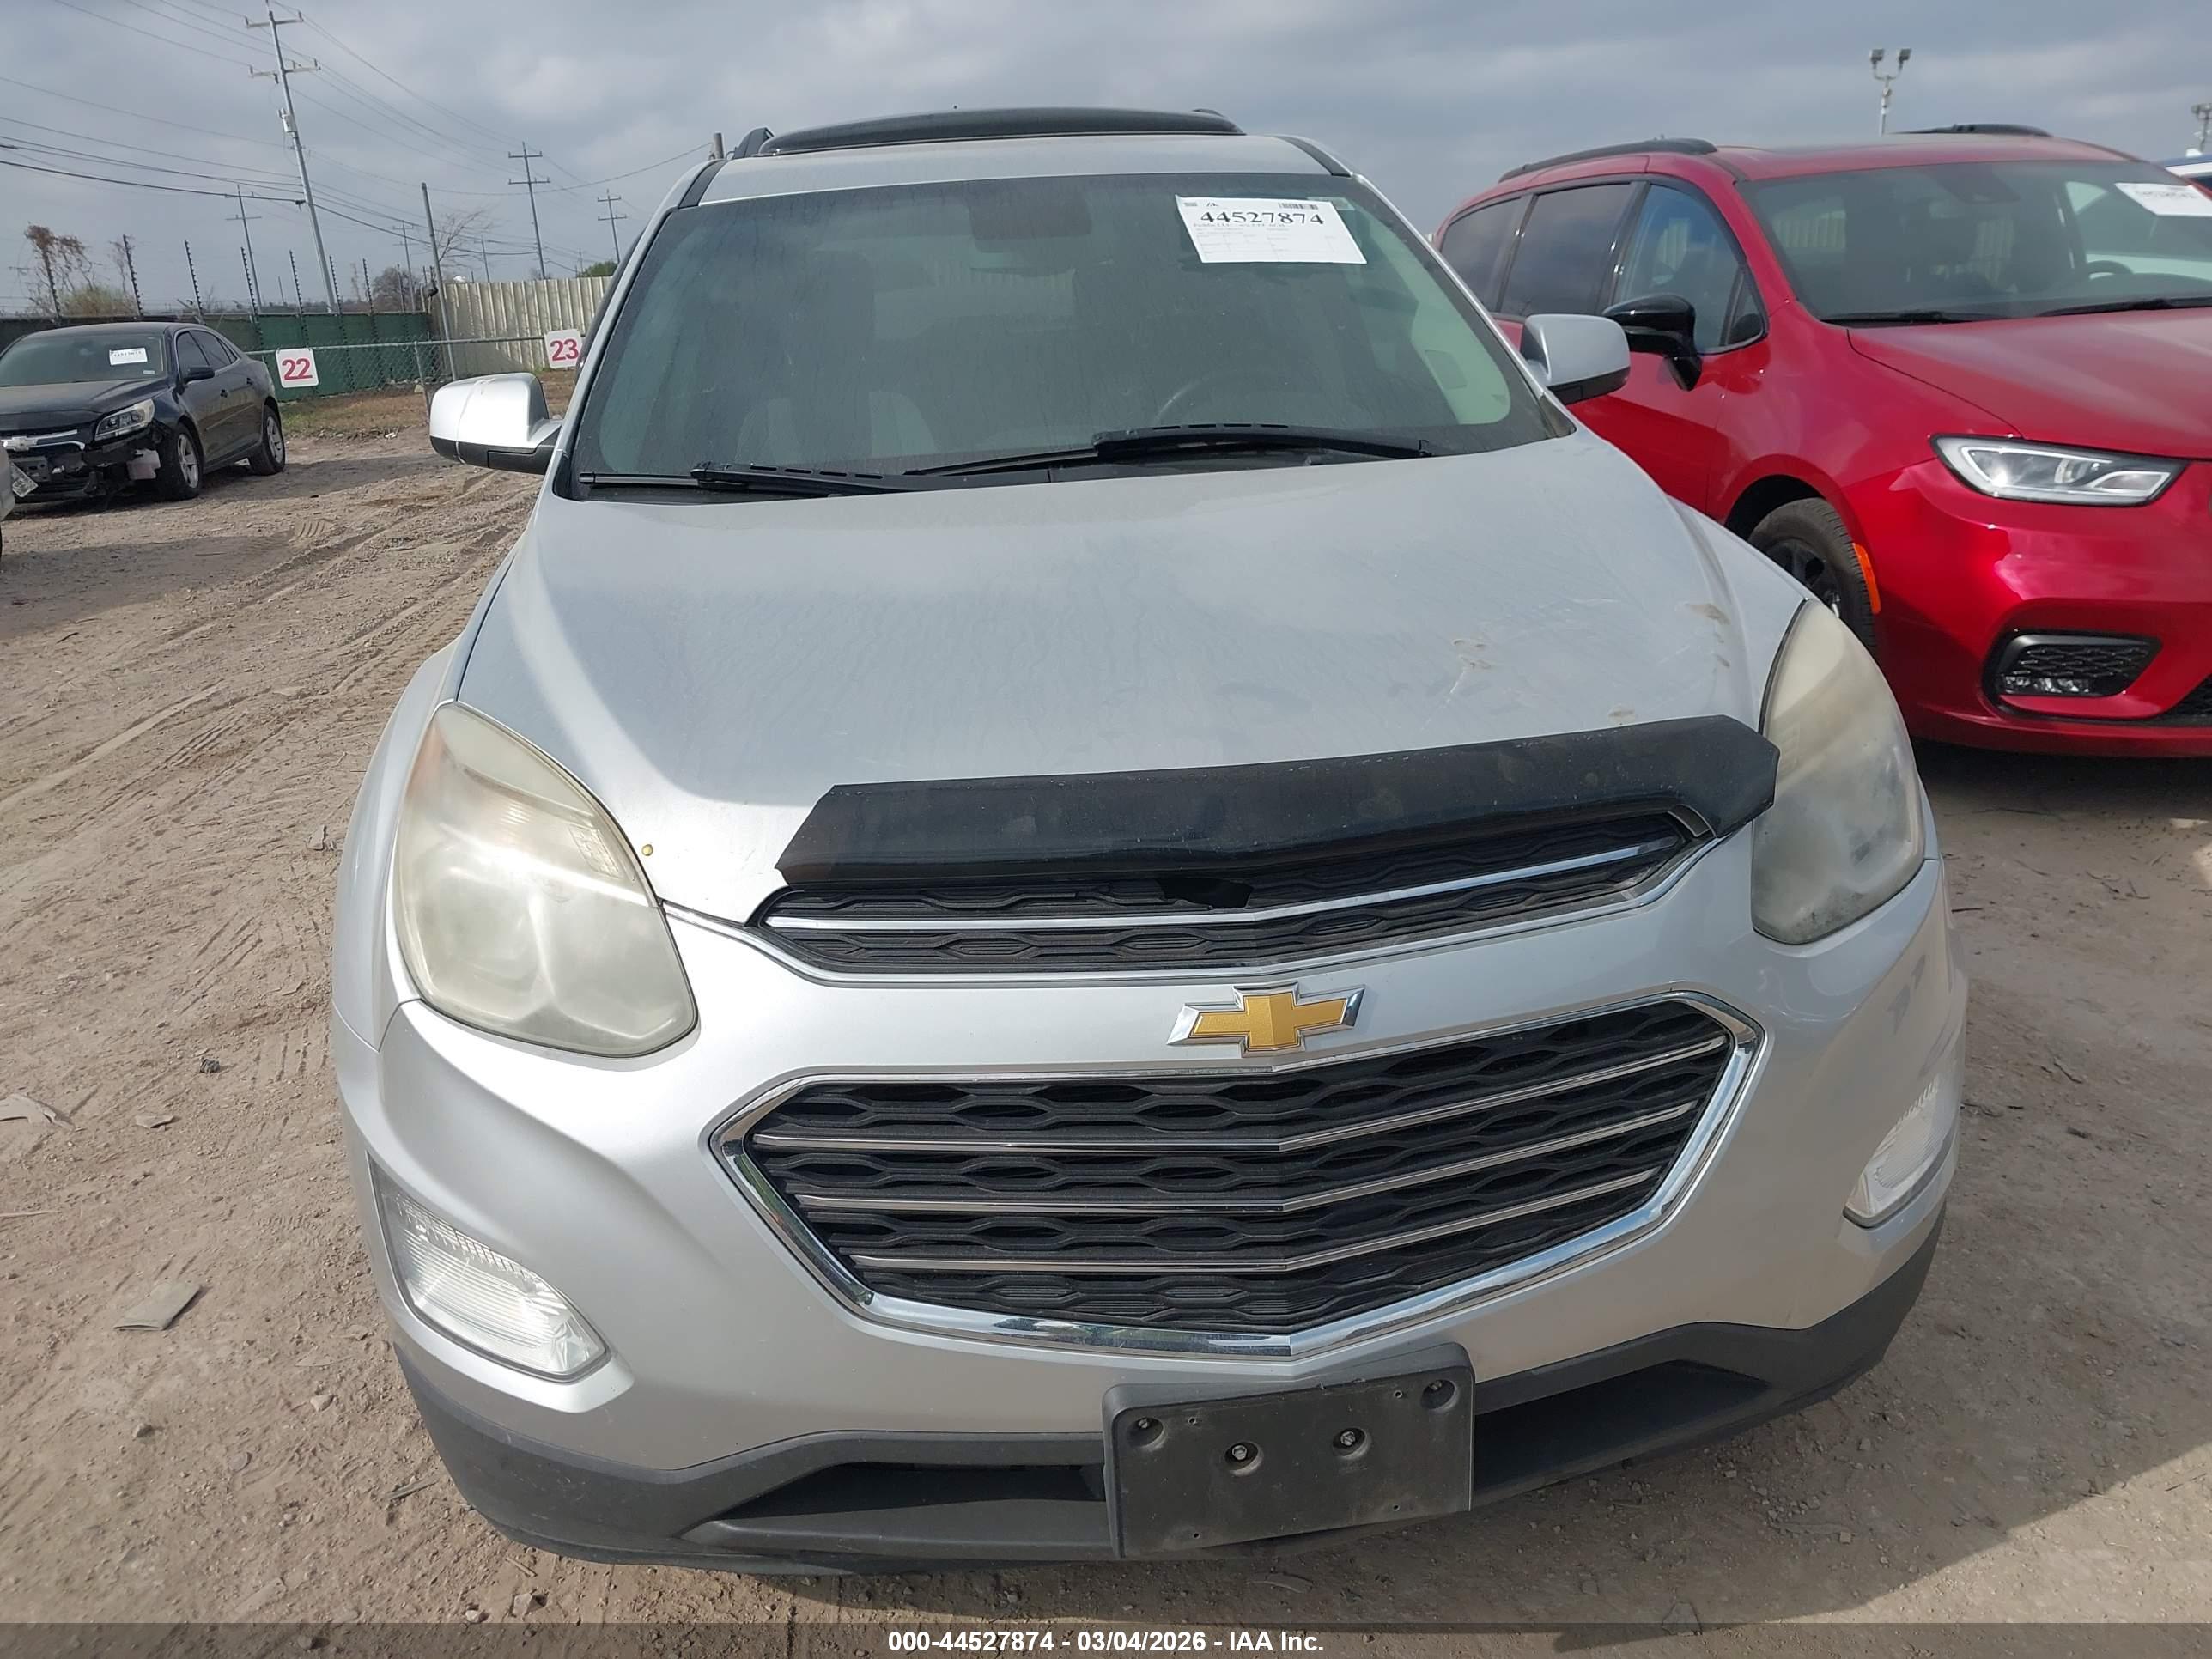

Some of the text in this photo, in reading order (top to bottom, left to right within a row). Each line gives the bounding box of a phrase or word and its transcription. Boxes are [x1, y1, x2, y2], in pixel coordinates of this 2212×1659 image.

[1200, 211, 1324, 224] 44527874
[550, 338, 579, 361] 23
[282, 358, 313, 380] 22
